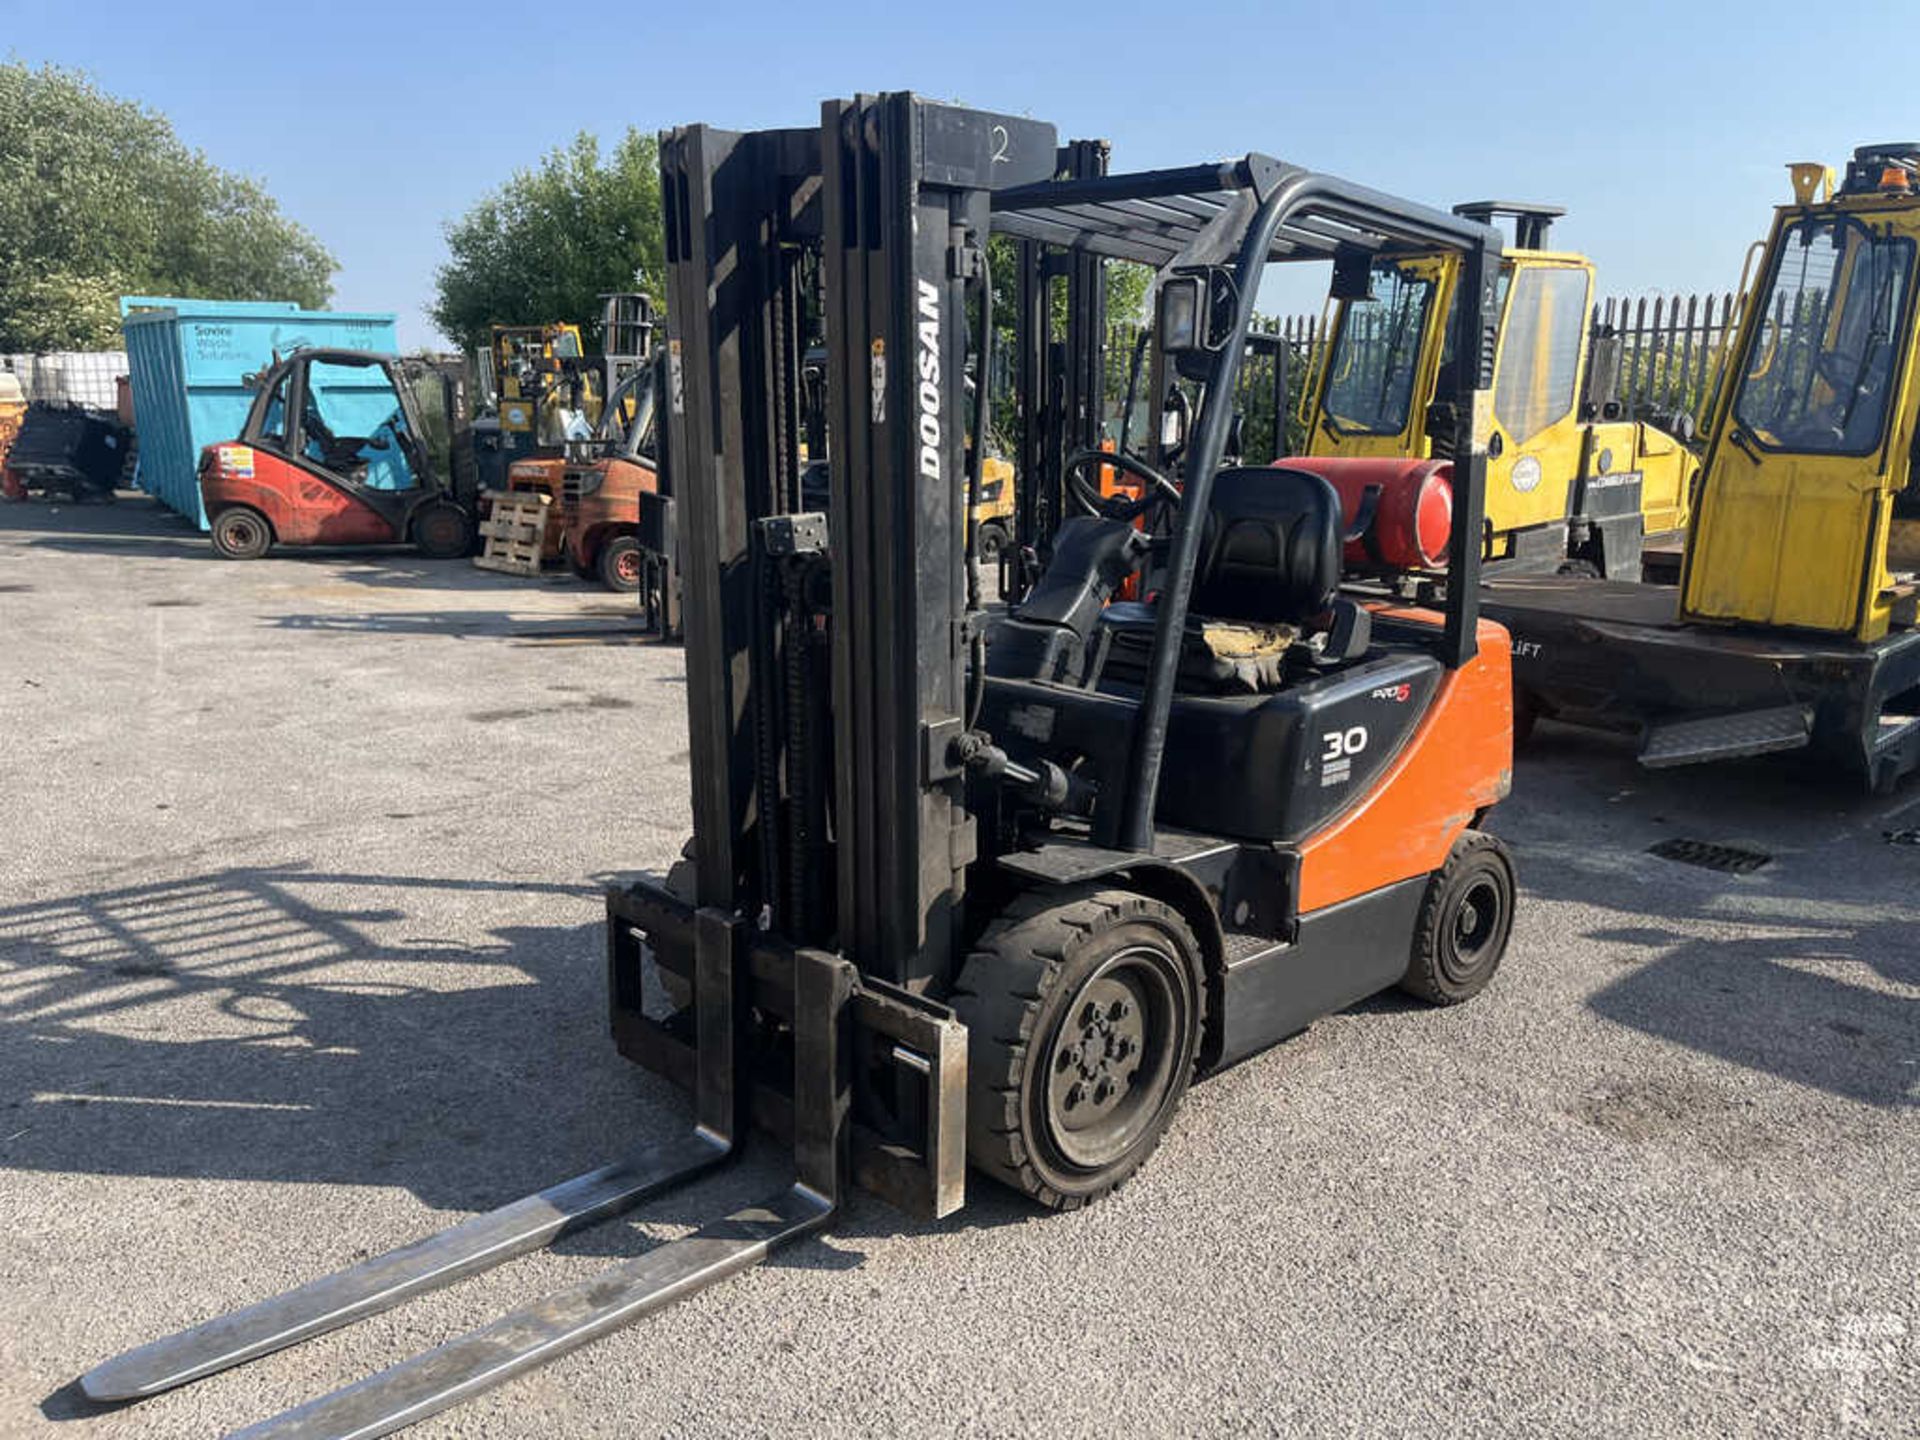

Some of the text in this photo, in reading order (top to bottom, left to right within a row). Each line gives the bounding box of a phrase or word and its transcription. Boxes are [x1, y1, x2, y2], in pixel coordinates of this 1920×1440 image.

[992, 125, 1010, 163] 2
[918, 278, 940, 481] DOOSAN
[1322, 726, 1368, 761] 30
